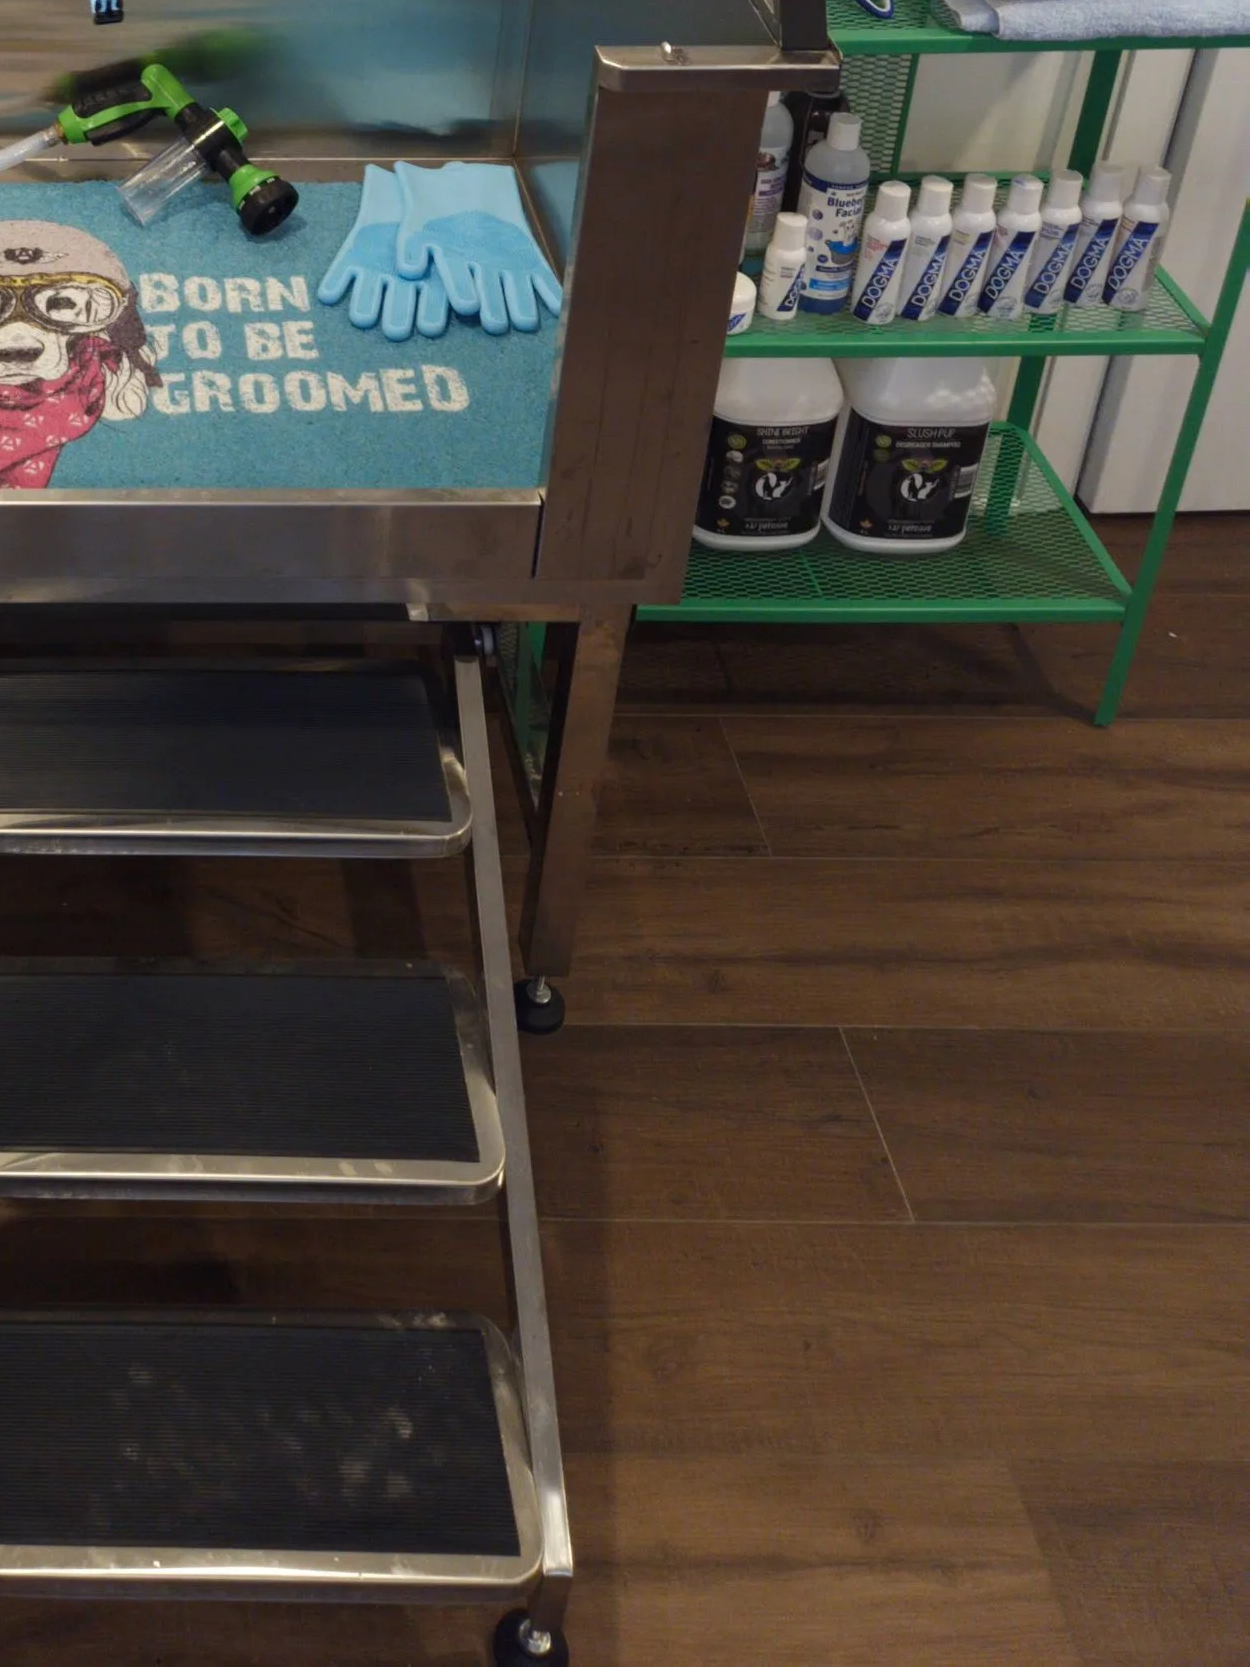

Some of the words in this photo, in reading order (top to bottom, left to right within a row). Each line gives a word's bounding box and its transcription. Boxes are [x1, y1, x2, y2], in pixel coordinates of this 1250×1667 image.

[861, 258, 899, 309] DOGMA
[911, 252, 947, 307] DOGMA
[949, 248, 988, 302] DOGMA
[985, 249, 1025, 300] DOGMA
[1034, 241, 1075, 295] DOGMA
[1070, 236, 1110, 290] DOGMA
[1108, 236, 1149, 290] DOGMA
[140, 272, 310, 314] BORN
[145, 321, 223, 361] TO
[244, 320, 320, 361] BE
[150, 364, 471, 415] GROOMED
